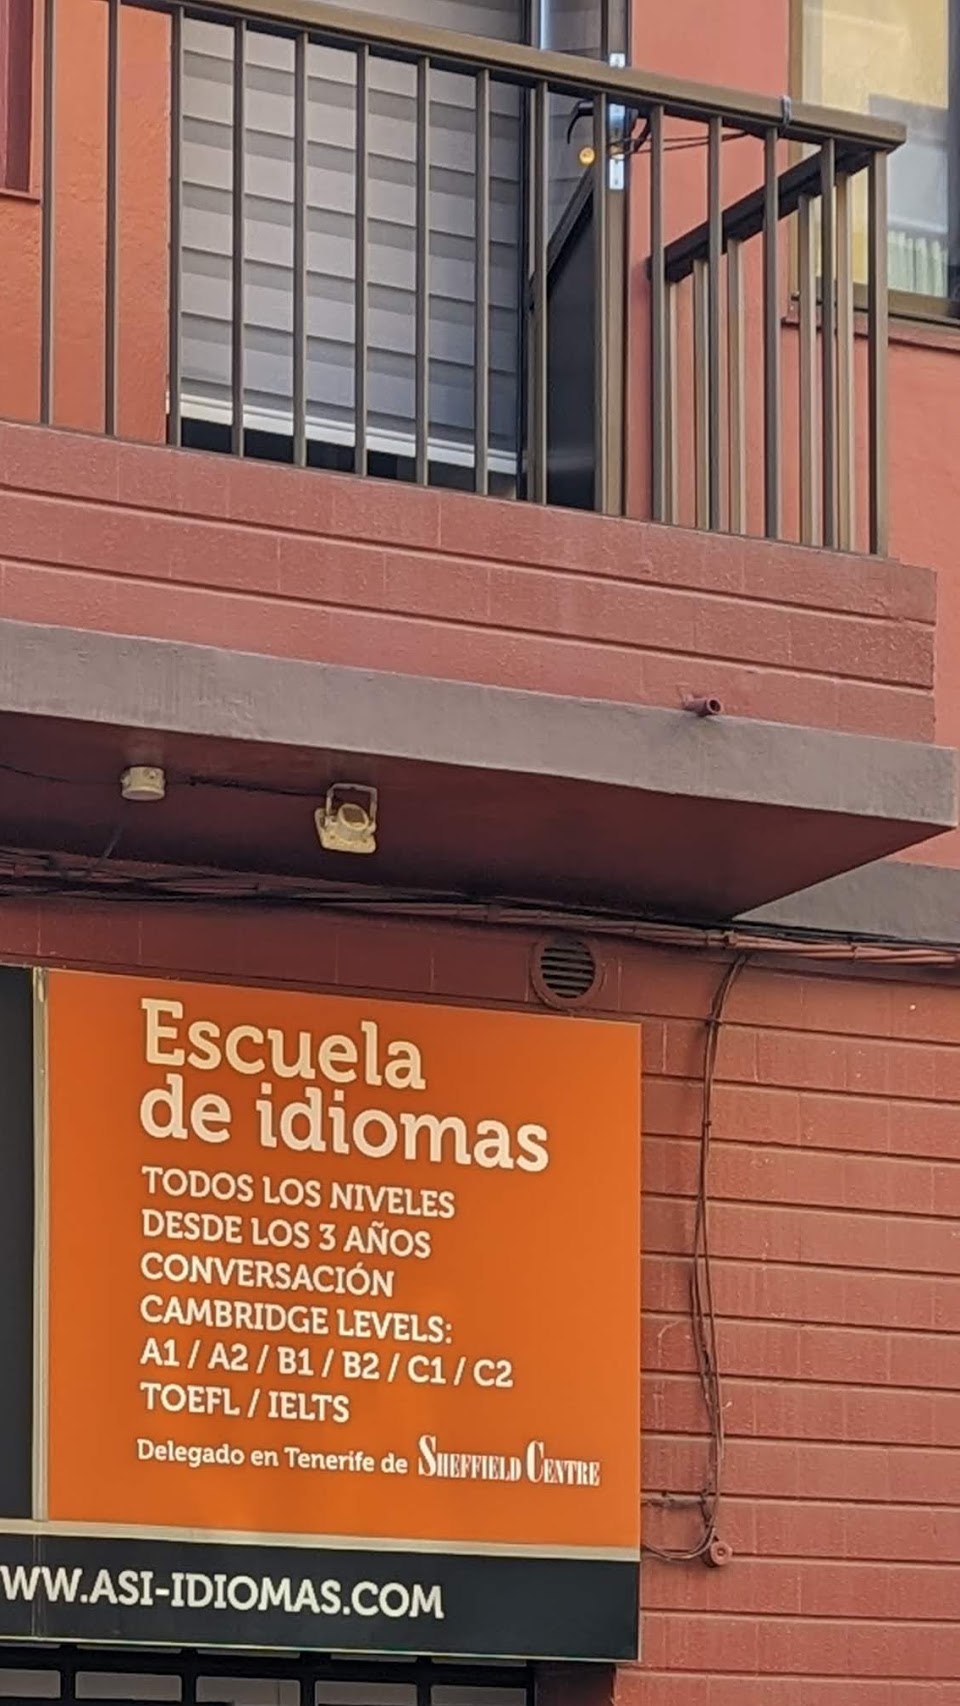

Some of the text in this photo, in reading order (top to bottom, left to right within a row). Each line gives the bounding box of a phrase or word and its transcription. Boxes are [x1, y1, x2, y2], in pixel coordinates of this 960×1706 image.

[142, 998, 425, 1089] Escuela
[141, 1074, 548, 1171] de idiomas
[142, 1166, 454, 1218] TODOS LOS NIVELES
[142, 1209, 430, 1258] DESDE LOS 3 AÑOS
[141, 1252, 394, 1296] CONVERSACIÓN
[141, 1295, 451, 1343] CAMBRIDGE LEVELS:
[141, 1338, 179, 1366] A1
[208, 1343, 248, 1370] A2
[278, 1347, 313, 1375] B1
[343, 1352, 379, 1379] B2
[408, 1355, 445, 1383] C1
[474, 1360, 512, 1387] C2
[141, 1382, 240, 1415] TOEFL
[269, 1391, 348, 1422] IELTS
[137, 1439, 244, 1467] Delegado
[251, 1451, 278, 1466] en
[284, 1447, 374, 1471] Tenerife
[381, 1453, 407, 1473] de
